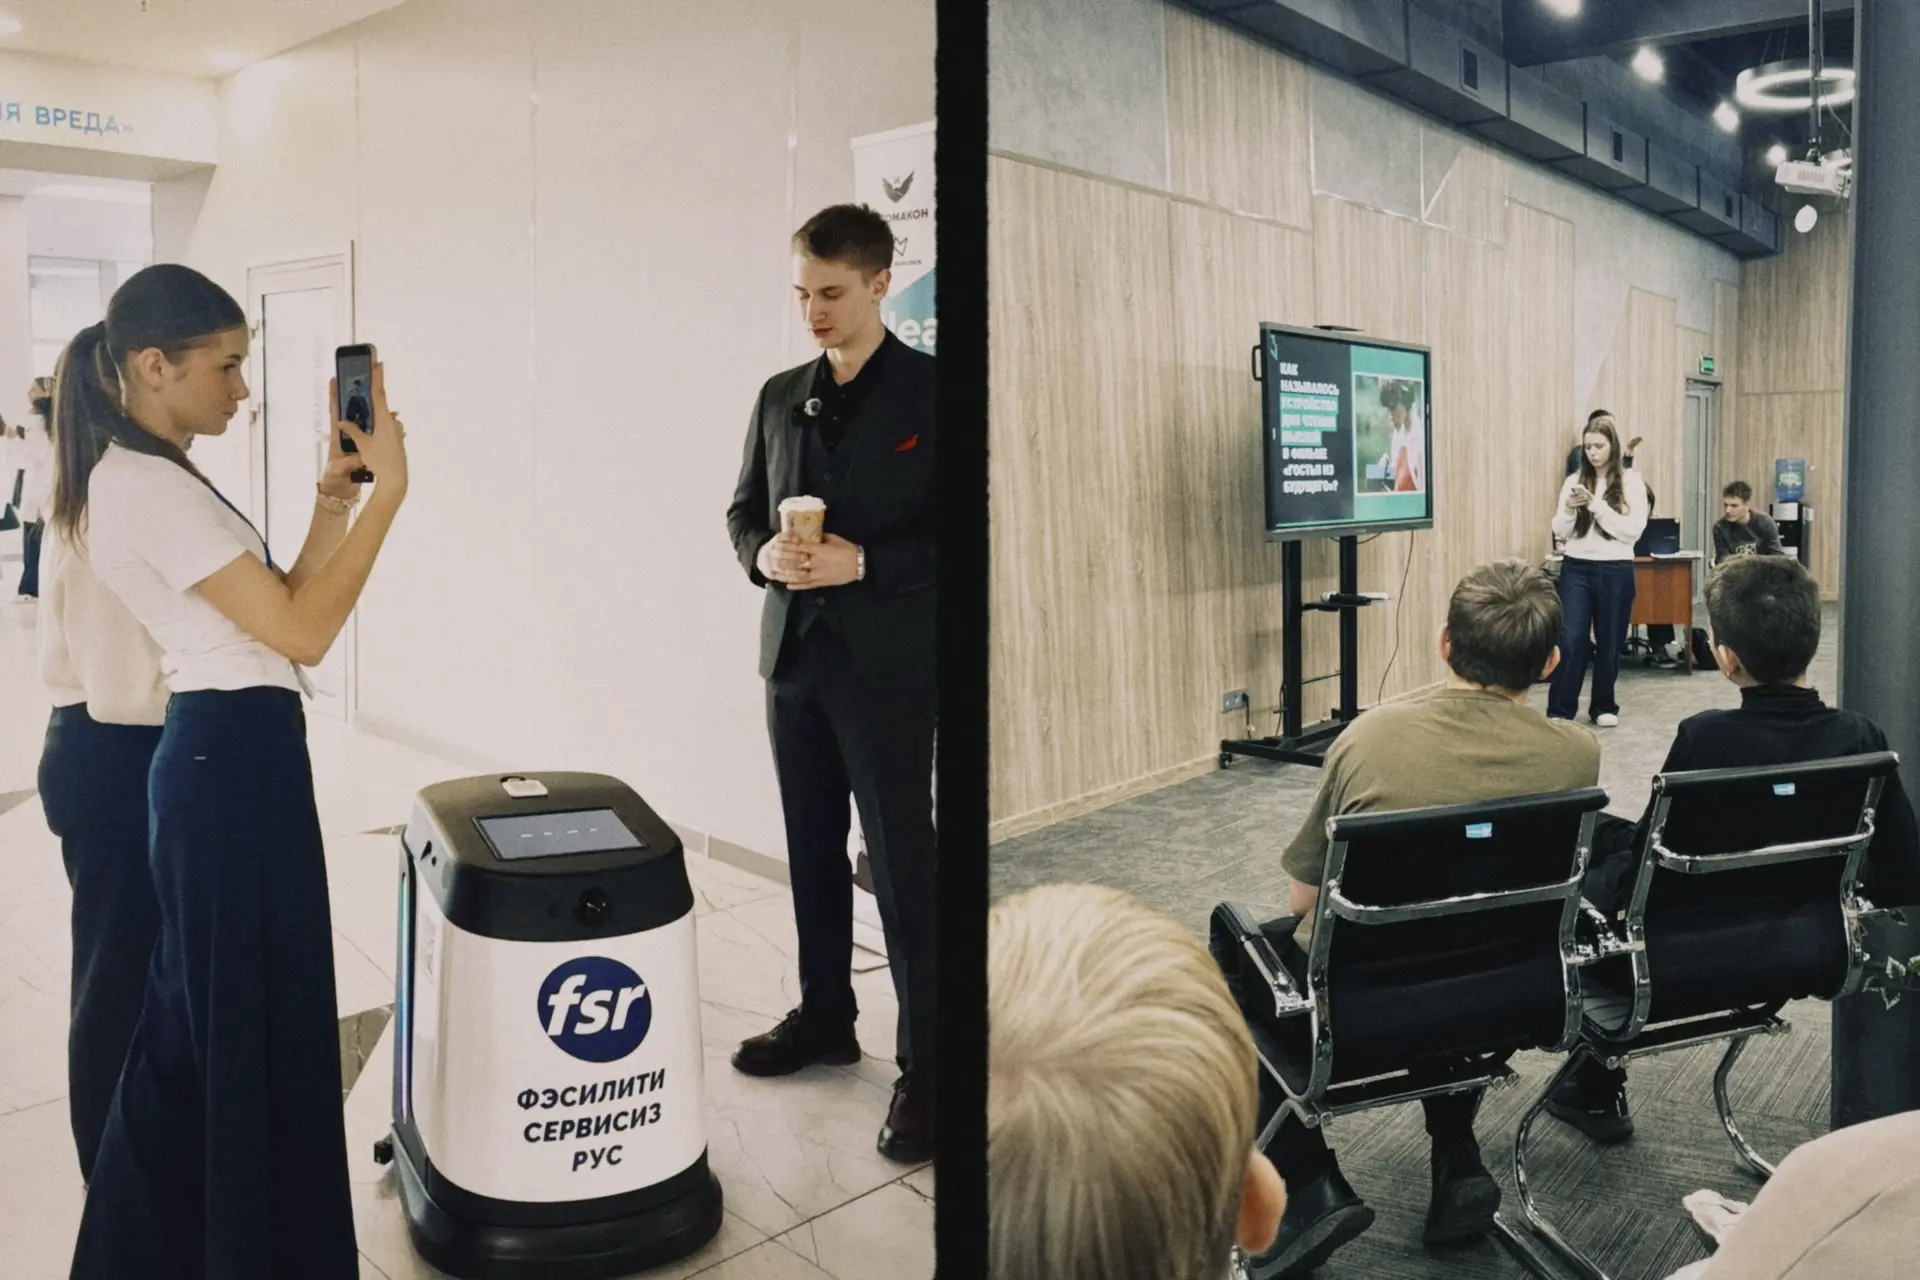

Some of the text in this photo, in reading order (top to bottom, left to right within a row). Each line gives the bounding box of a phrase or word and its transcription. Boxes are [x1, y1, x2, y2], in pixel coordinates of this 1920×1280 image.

[0, 101, 134, 136] Я ВРЕДА»
[1279, 361, 1299, 376] КАК
[1280, 379, 1340, 396] НАЗЫВАЛОСЬ
[547, 974, 646, 1036] fsr
[516, 1068, 665, 1110] ФЭСИЛИТИ
[523, 1102, 661, 1143] СЕРВИСИЗ
[571, 1145, 623, 1172] РУС
